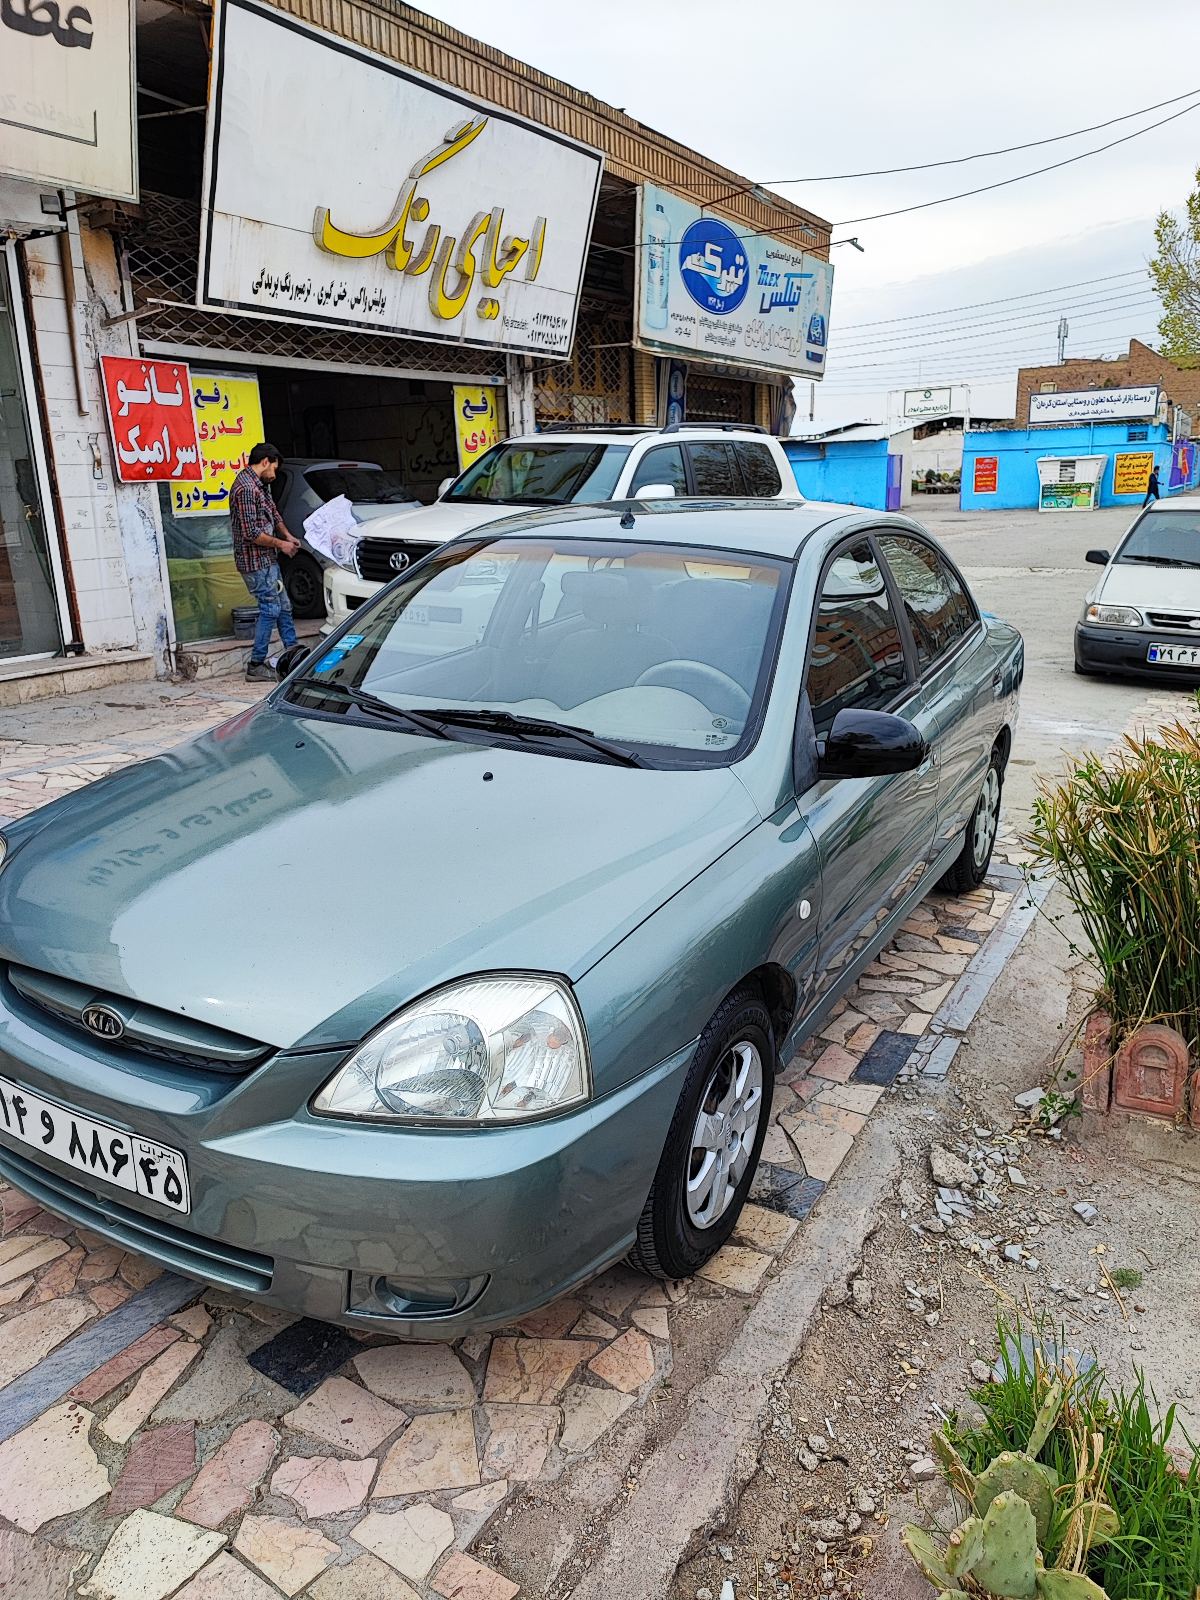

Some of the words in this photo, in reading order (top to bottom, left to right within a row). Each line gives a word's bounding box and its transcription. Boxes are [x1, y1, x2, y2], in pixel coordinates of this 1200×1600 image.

[313, 114, 489, 276] رنگ
[428, 206, 547, 320] احیای
[117, 364, 183, 416] نانو
[194, 382, 229, 409] رفع
[462, 391, 494, 421] رفع
[118, 424, 197, 476] سرامیک
[175, 481, 229, 508] خودرو
[1159, 648, 1173, 660] ۷۹
[87, 1011, 117, 1035] KIA
[40, 1109, 55, 1145] و
[68, 1121, 129, 1178] ۸۸۶
[139, 1142, 176, 1165] ایران
[139, 1157, 183, 1206] ۴۵
